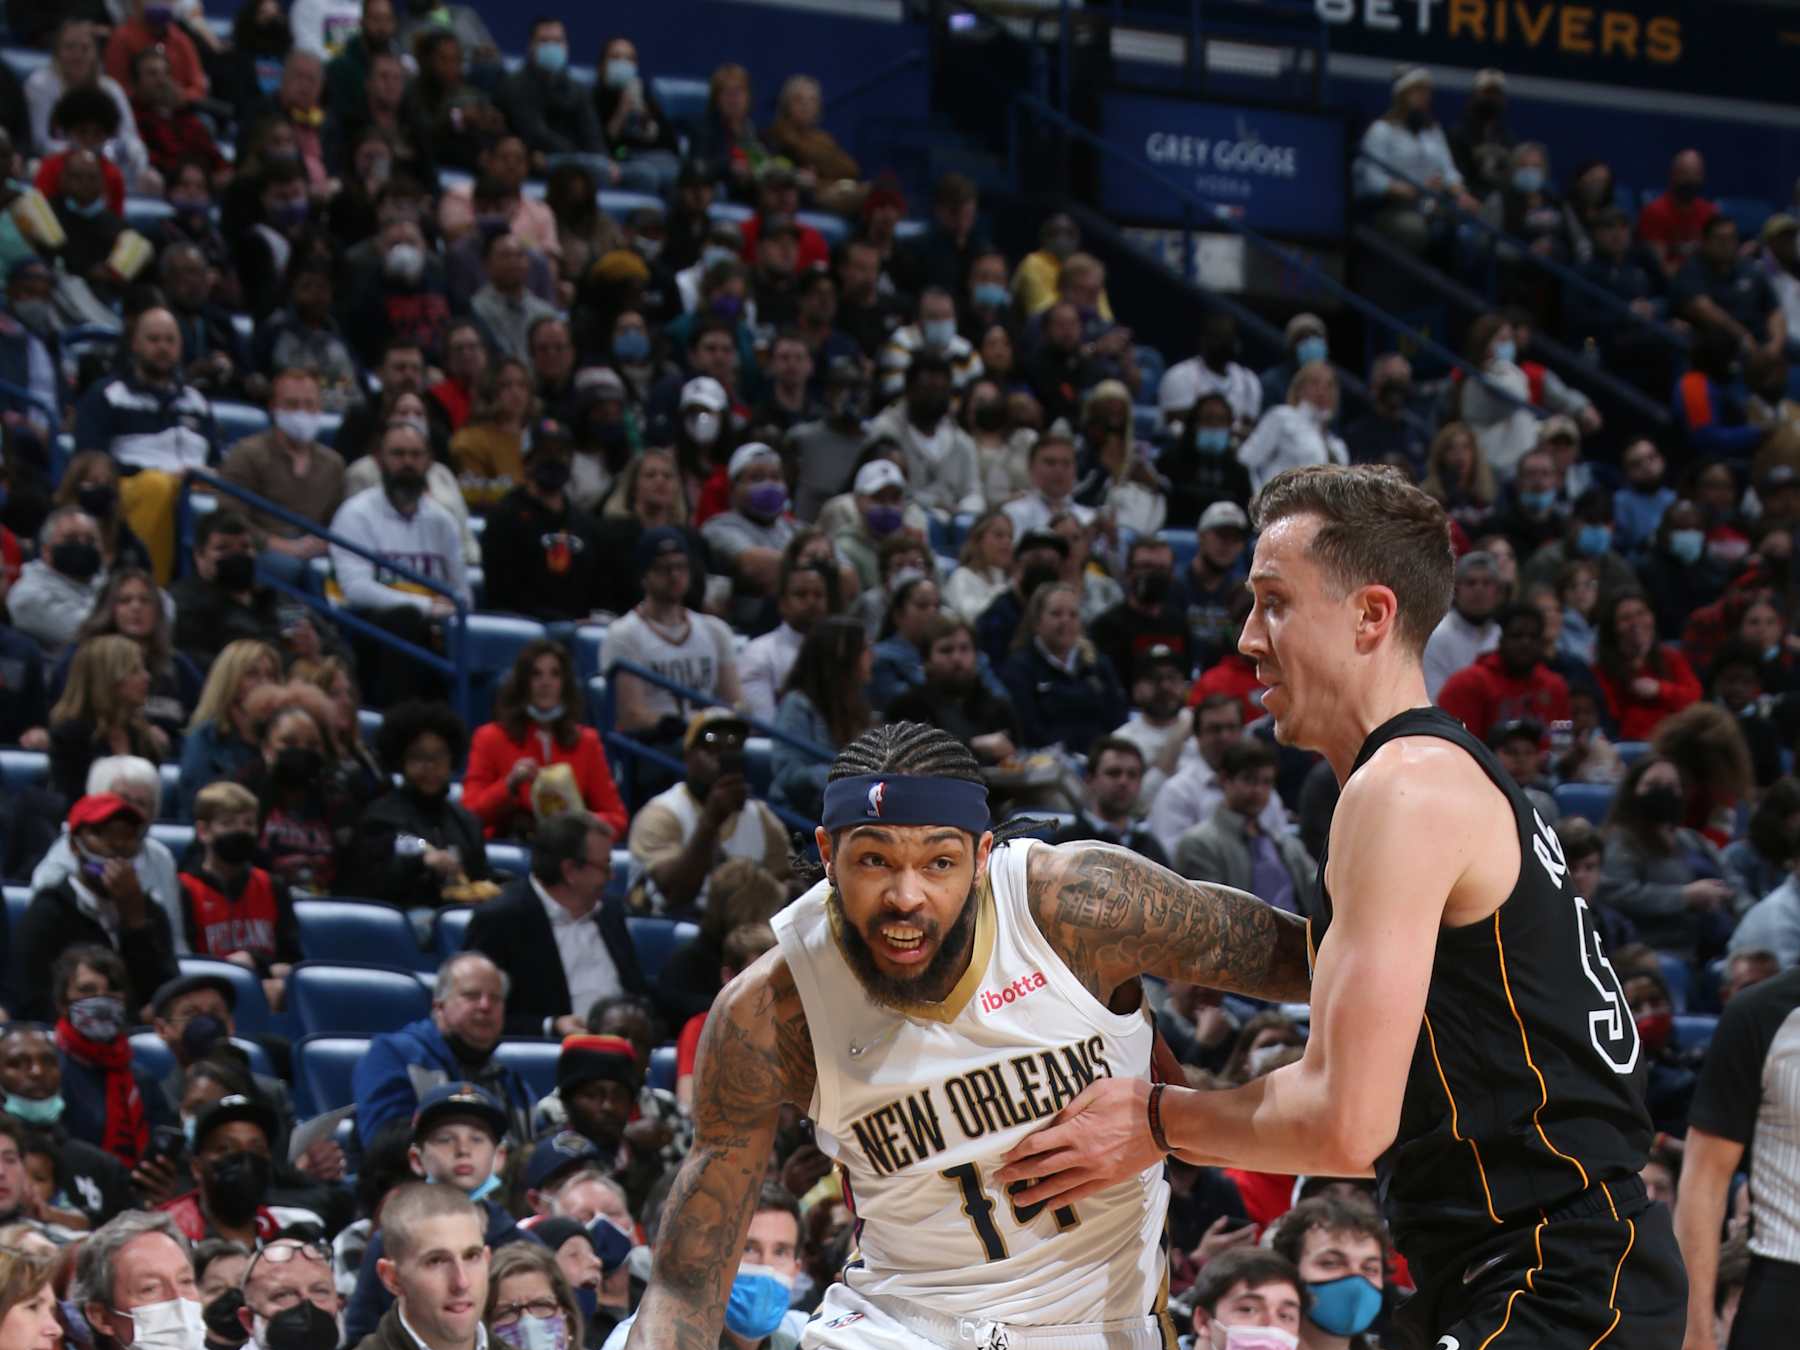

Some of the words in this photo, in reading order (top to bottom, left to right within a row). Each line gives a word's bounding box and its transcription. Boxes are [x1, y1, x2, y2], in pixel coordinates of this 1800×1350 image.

[1145, 131, 1210, 166] GREY
[1213, 138, 1298, 177] GOOSE
[980, 972, 1048, 1013] ibotta
[850, 1086, 947, 1177] NEW
[943, 1034, 1113, 1140] ORLEANS
